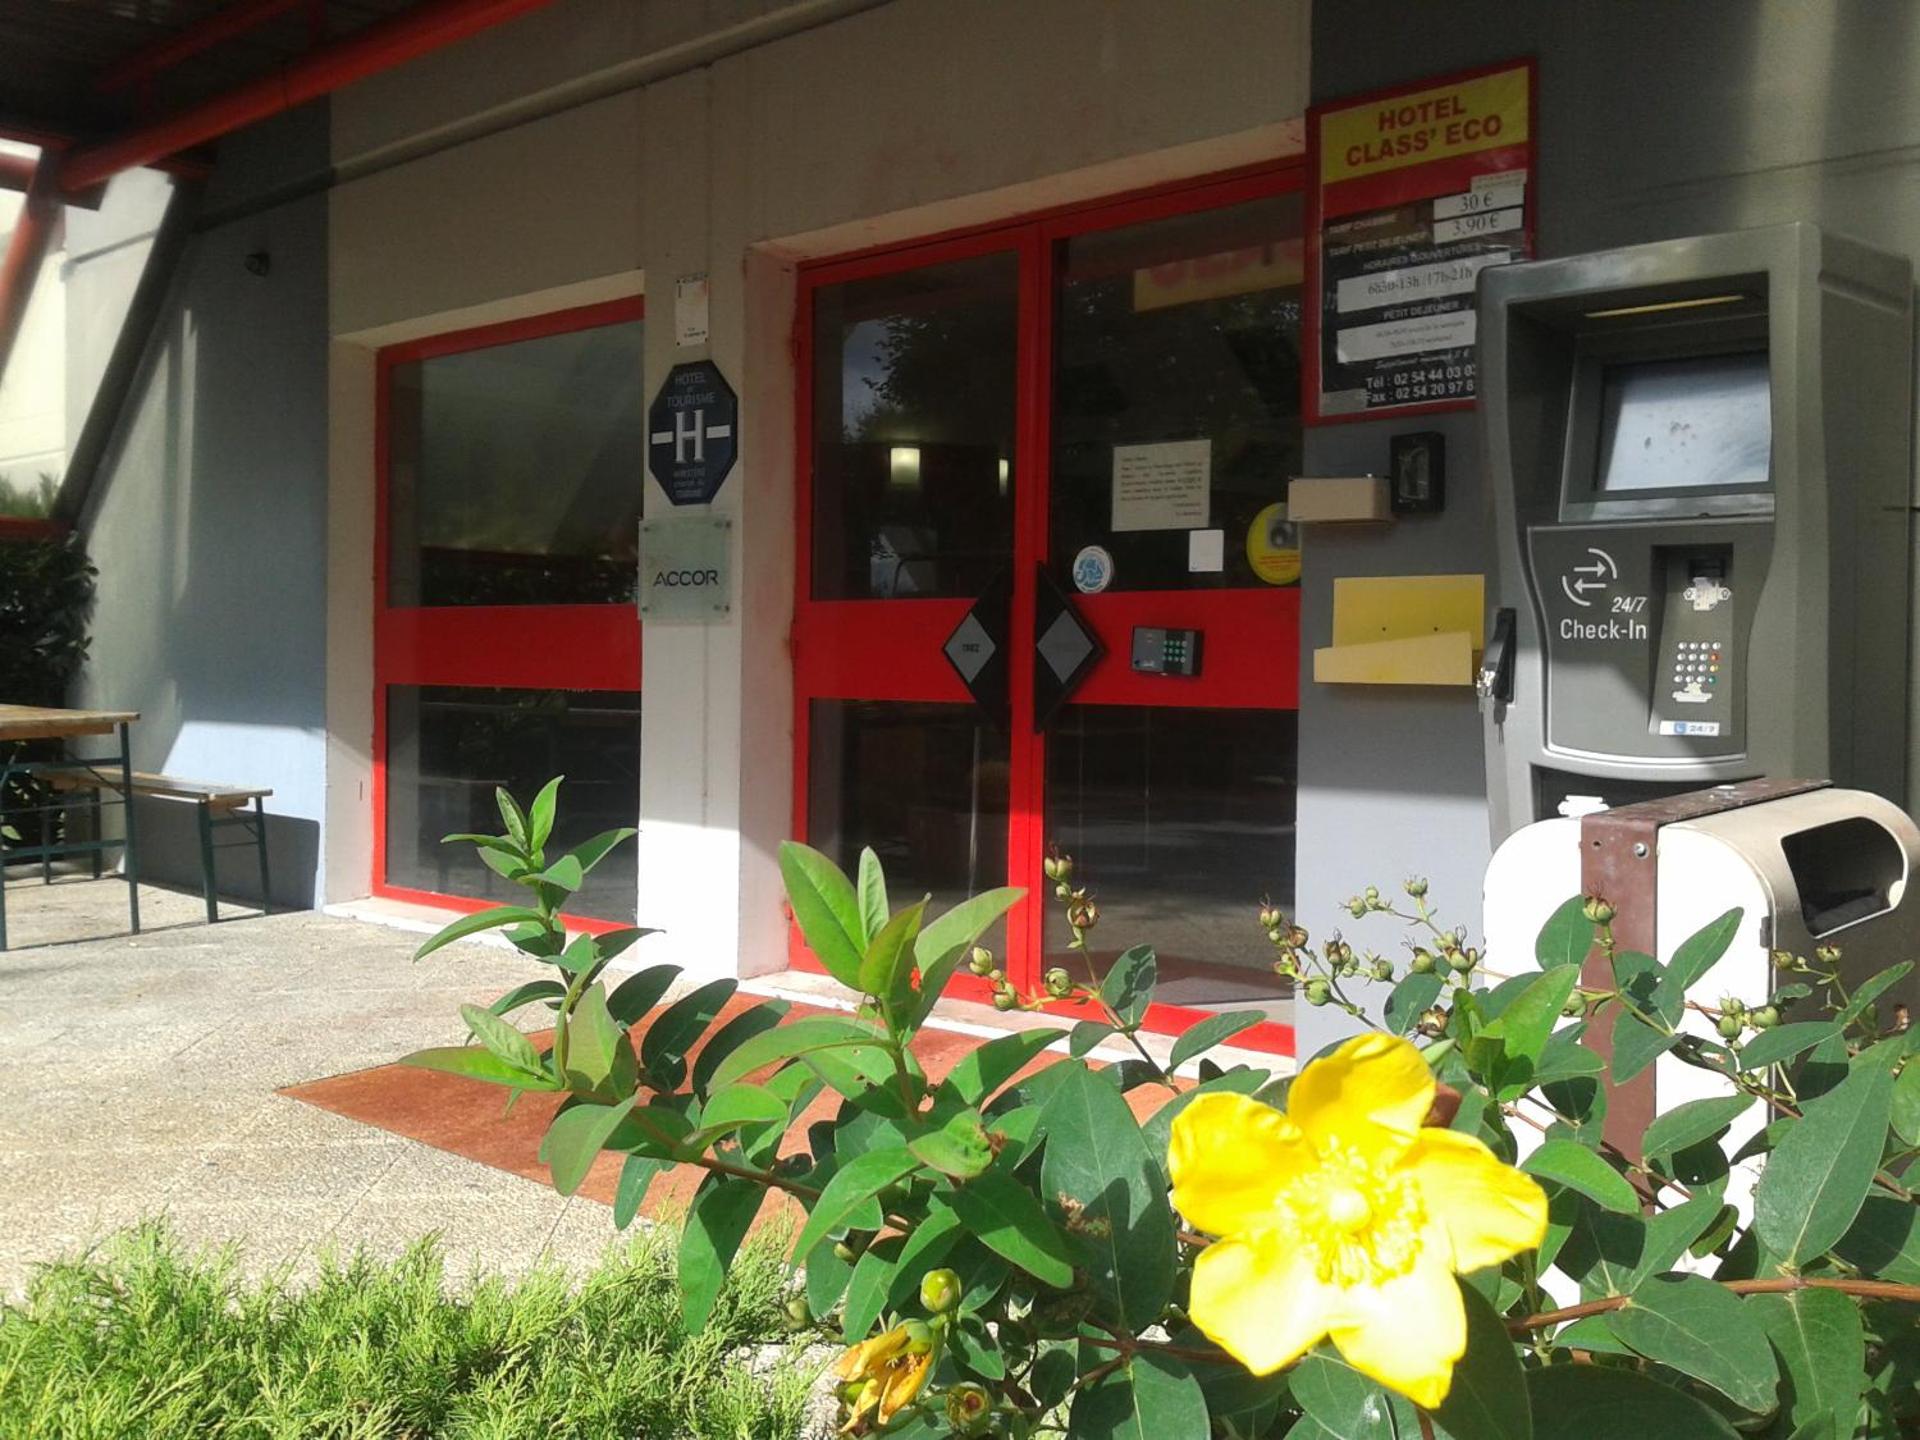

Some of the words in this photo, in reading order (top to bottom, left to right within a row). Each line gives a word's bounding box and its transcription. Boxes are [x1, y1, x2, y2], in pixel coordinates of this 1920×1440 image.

[1378, 96, 1468, 131] HOTEL
[1346, 129, 1437, 167] CLASS'
[1445, 114, 1502, 146] ECO
[1461, 192, 1480, 211] 30
[1484, 190, 1495, 208] €
[1393, 373, 1410, 386] 02
[1411, 370, 1426, 384] 54
[1427, 367, 1444, 381] 44
[1395, 387, 1411, 400] 02
[1412, 384, 1428, 398] 54
[1430, 383, 1446, 396] 20
[1448, 381, 1464, 394] 97
[674, 408, 706, 464] H
[652, 568, 720, 588] ACCOR
[1611, 597, 1648, 614] 24/7
[1559, 618, 1648, 640] Check-In
